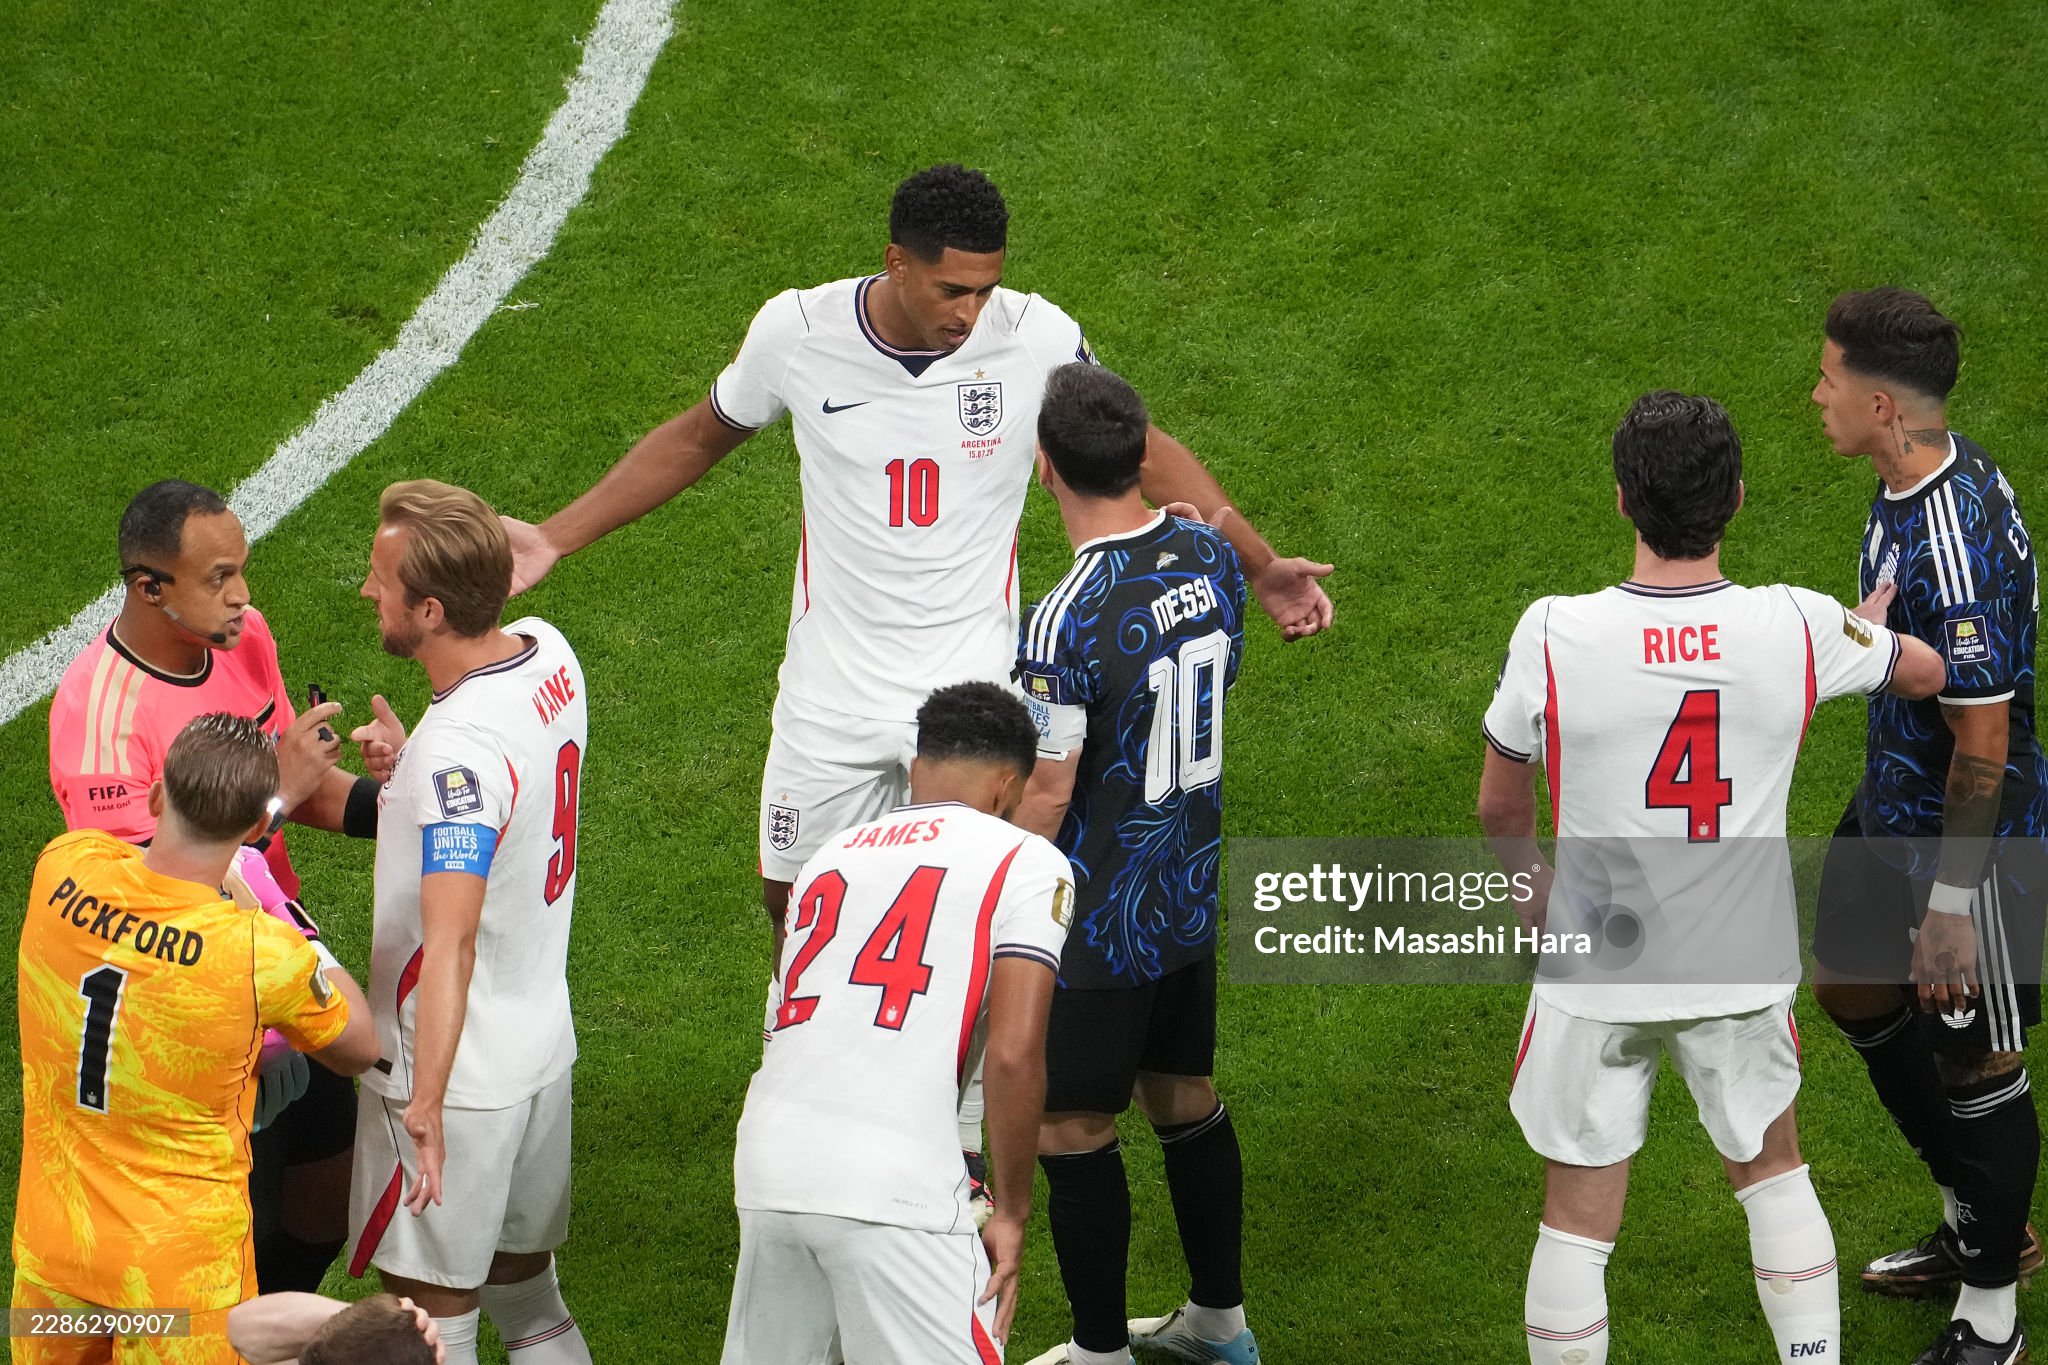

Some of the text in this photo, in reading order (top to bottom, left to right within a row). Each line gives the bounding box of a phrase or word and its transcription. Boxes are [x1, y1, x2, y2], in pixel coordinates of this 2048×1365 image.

[961, 437, 1001, 449] ARGENTINA
[969, 448, 994, 459] 15.07.26
[885, 458, 939, 527] 10
[1151, 574, 1217, 635] MESSI
[1643, 624, 1721, 664] RICE
[1953, 644, 1984, 655] EDUCATION
[532, 665, 575, 728] KANE
[1145, 629, 1231, 805] 10
[1645, 689, 1732, 843] 4
[89, 784, 128, 801] FIFA
[93, 804, 114, 812] TEAM
[446, 794, 476, 808] EDUCATION
[433, 827, 477, 837] FOOTBALL
[544, 739, 580, 907] 9
[843, 818, 945, 849] JAMES
[432, 849, 480, 863] the World
[434, 836, 478, 850] UNITES
[48, 876, 204, 967] PICKFORD
[773, 865, 948, 1031] 24
[76, 963, 128, 1115] 1
[1790, 1339, 1827, 1357] ENG
